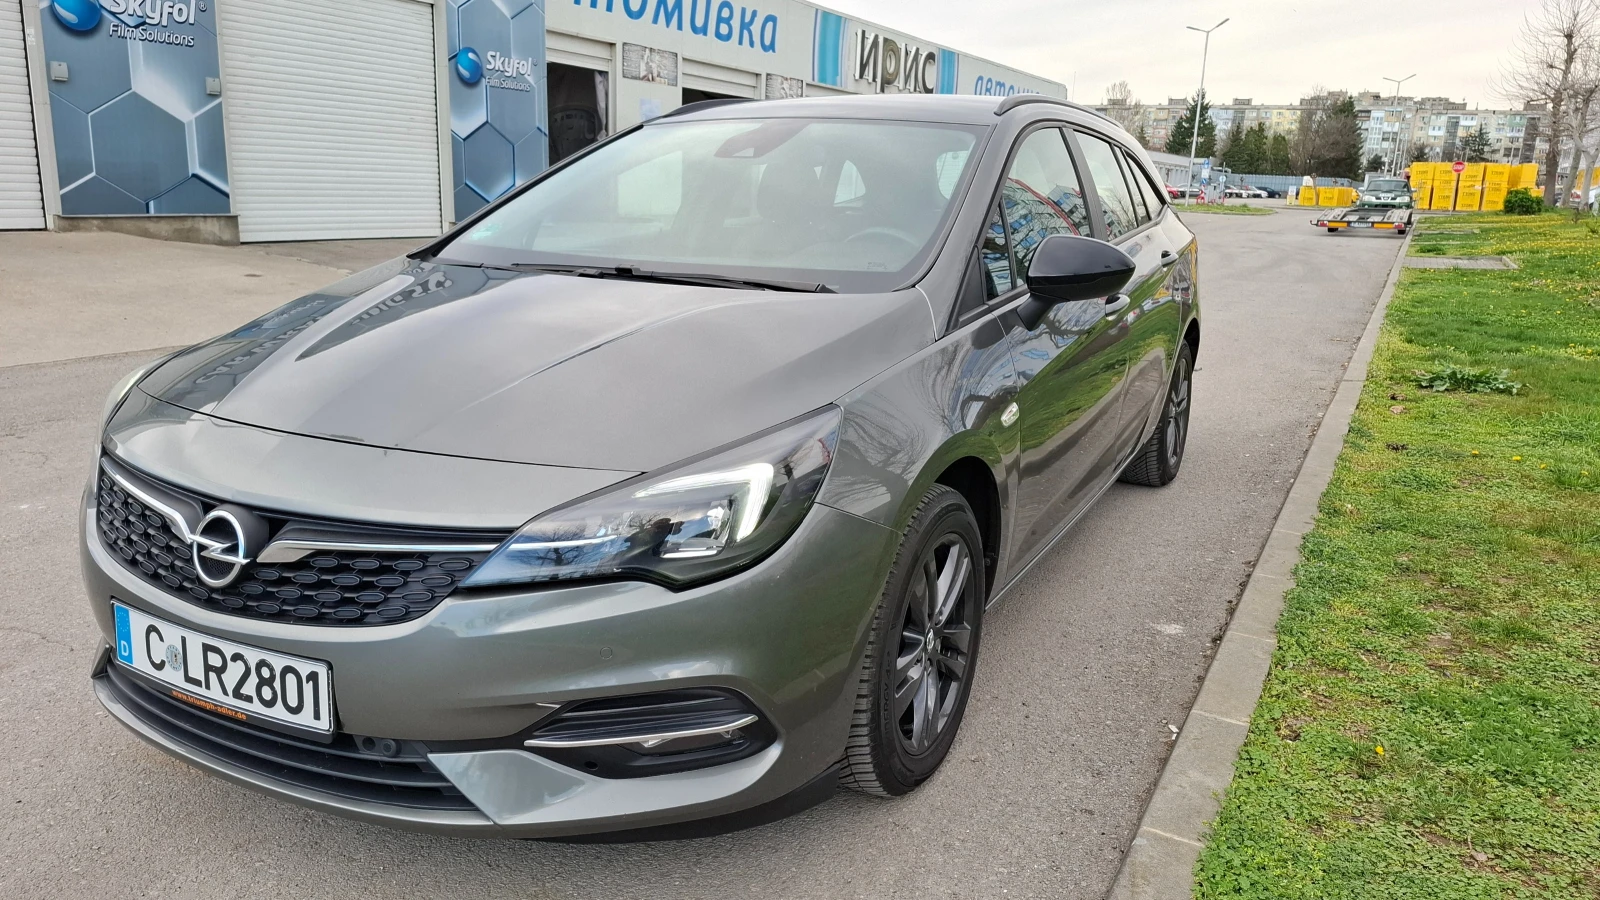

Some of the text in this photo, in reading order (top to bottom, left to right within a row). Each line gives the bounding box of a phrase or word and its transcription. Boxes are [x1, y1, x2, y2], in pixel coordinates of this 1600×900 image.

[110, 23, 194, 47] Film Solutions
[486, 76, 531, 92] Film Solutions
[120, 640, 130, 657] D
[145, 623, 167, 672] C
[171, 689, 248, 720] www.triumph-adler.de
